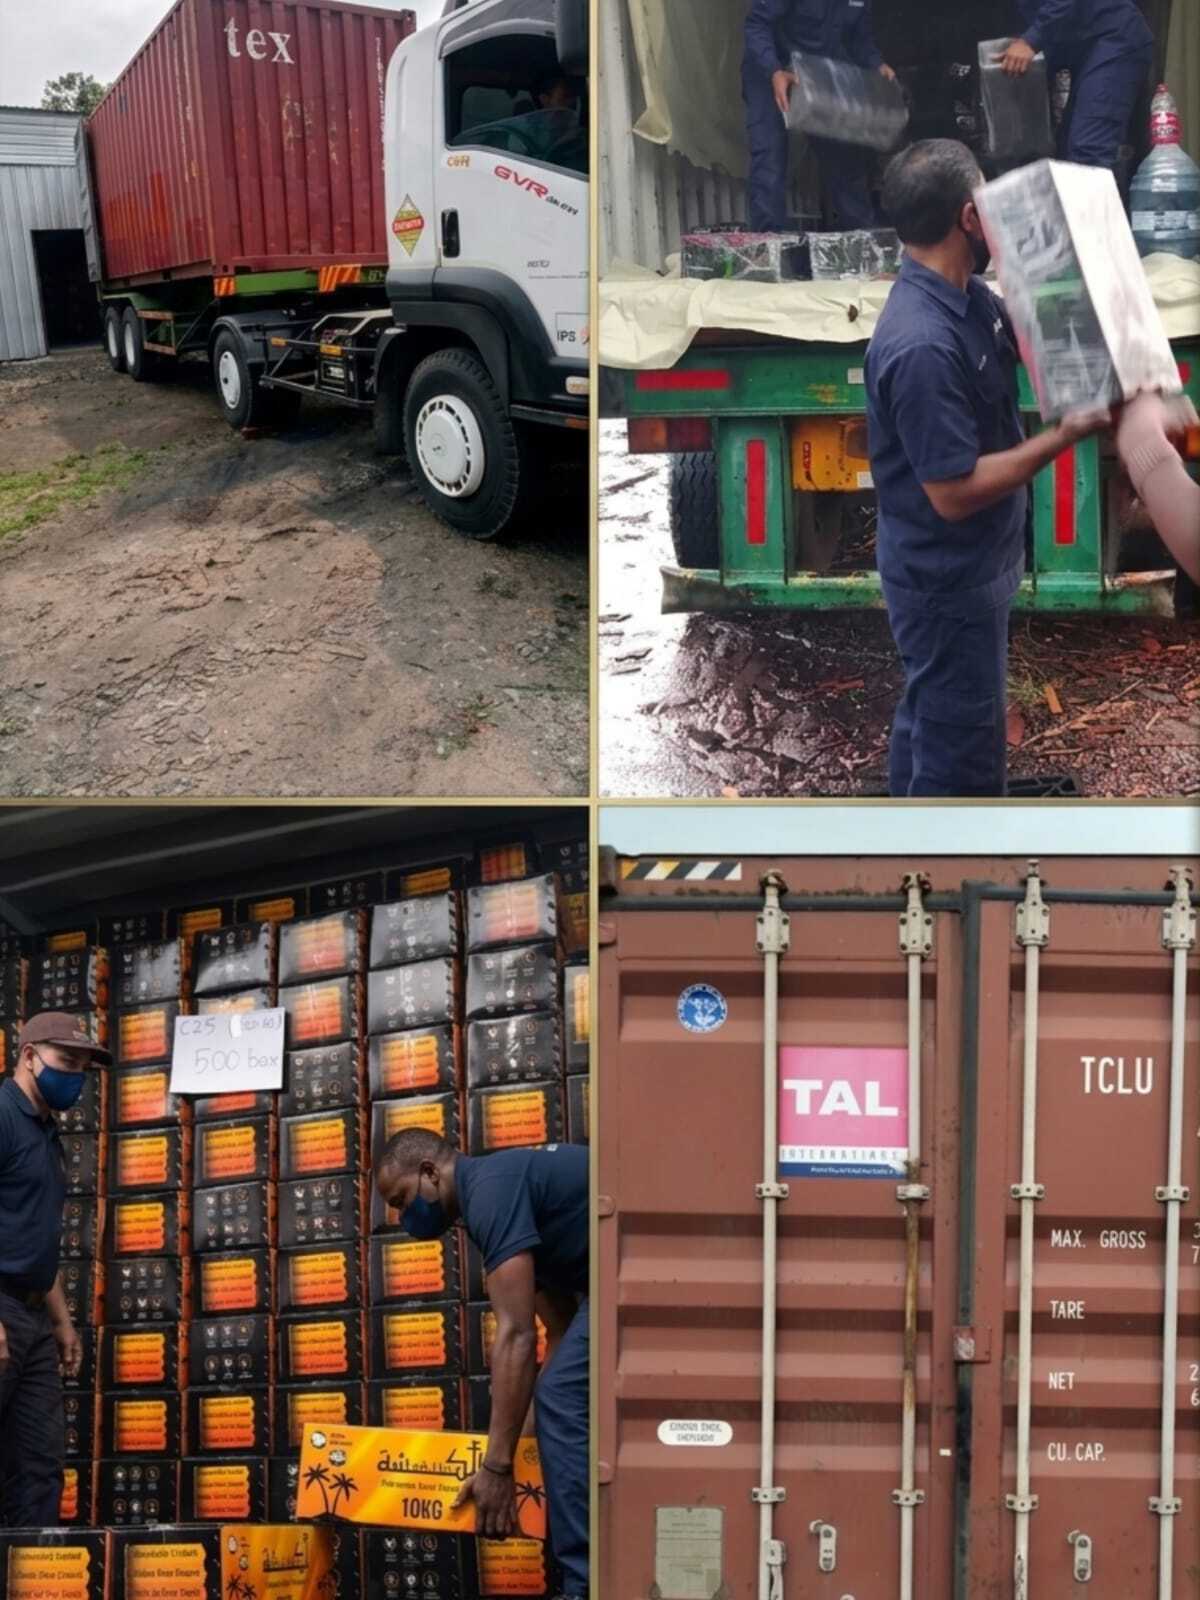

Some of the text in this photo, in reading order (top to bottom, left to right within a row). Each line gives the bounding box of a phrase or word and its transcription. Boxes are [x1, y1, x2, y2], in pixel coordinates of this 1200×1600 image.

[223, 16, 295, 65] tex
[493, 164, 549, 199] GVR
[556, 330, 577, 342] IPS
[194, 1047, 241, 1074] 500
[1080, 1056, 1153, 1095] TCLU
[783, 1078, 899, 1117] TAL
[1050, 1228, 1148, 1250] MAX. GROSS
[1049, 1300, 1086, 1320] TARE
[1048, 1372, 1076, 1390] NET
[1047, 1442, 1107, 1462] CU. CAP.
[401, 1497, 444, 1521] 10KG
